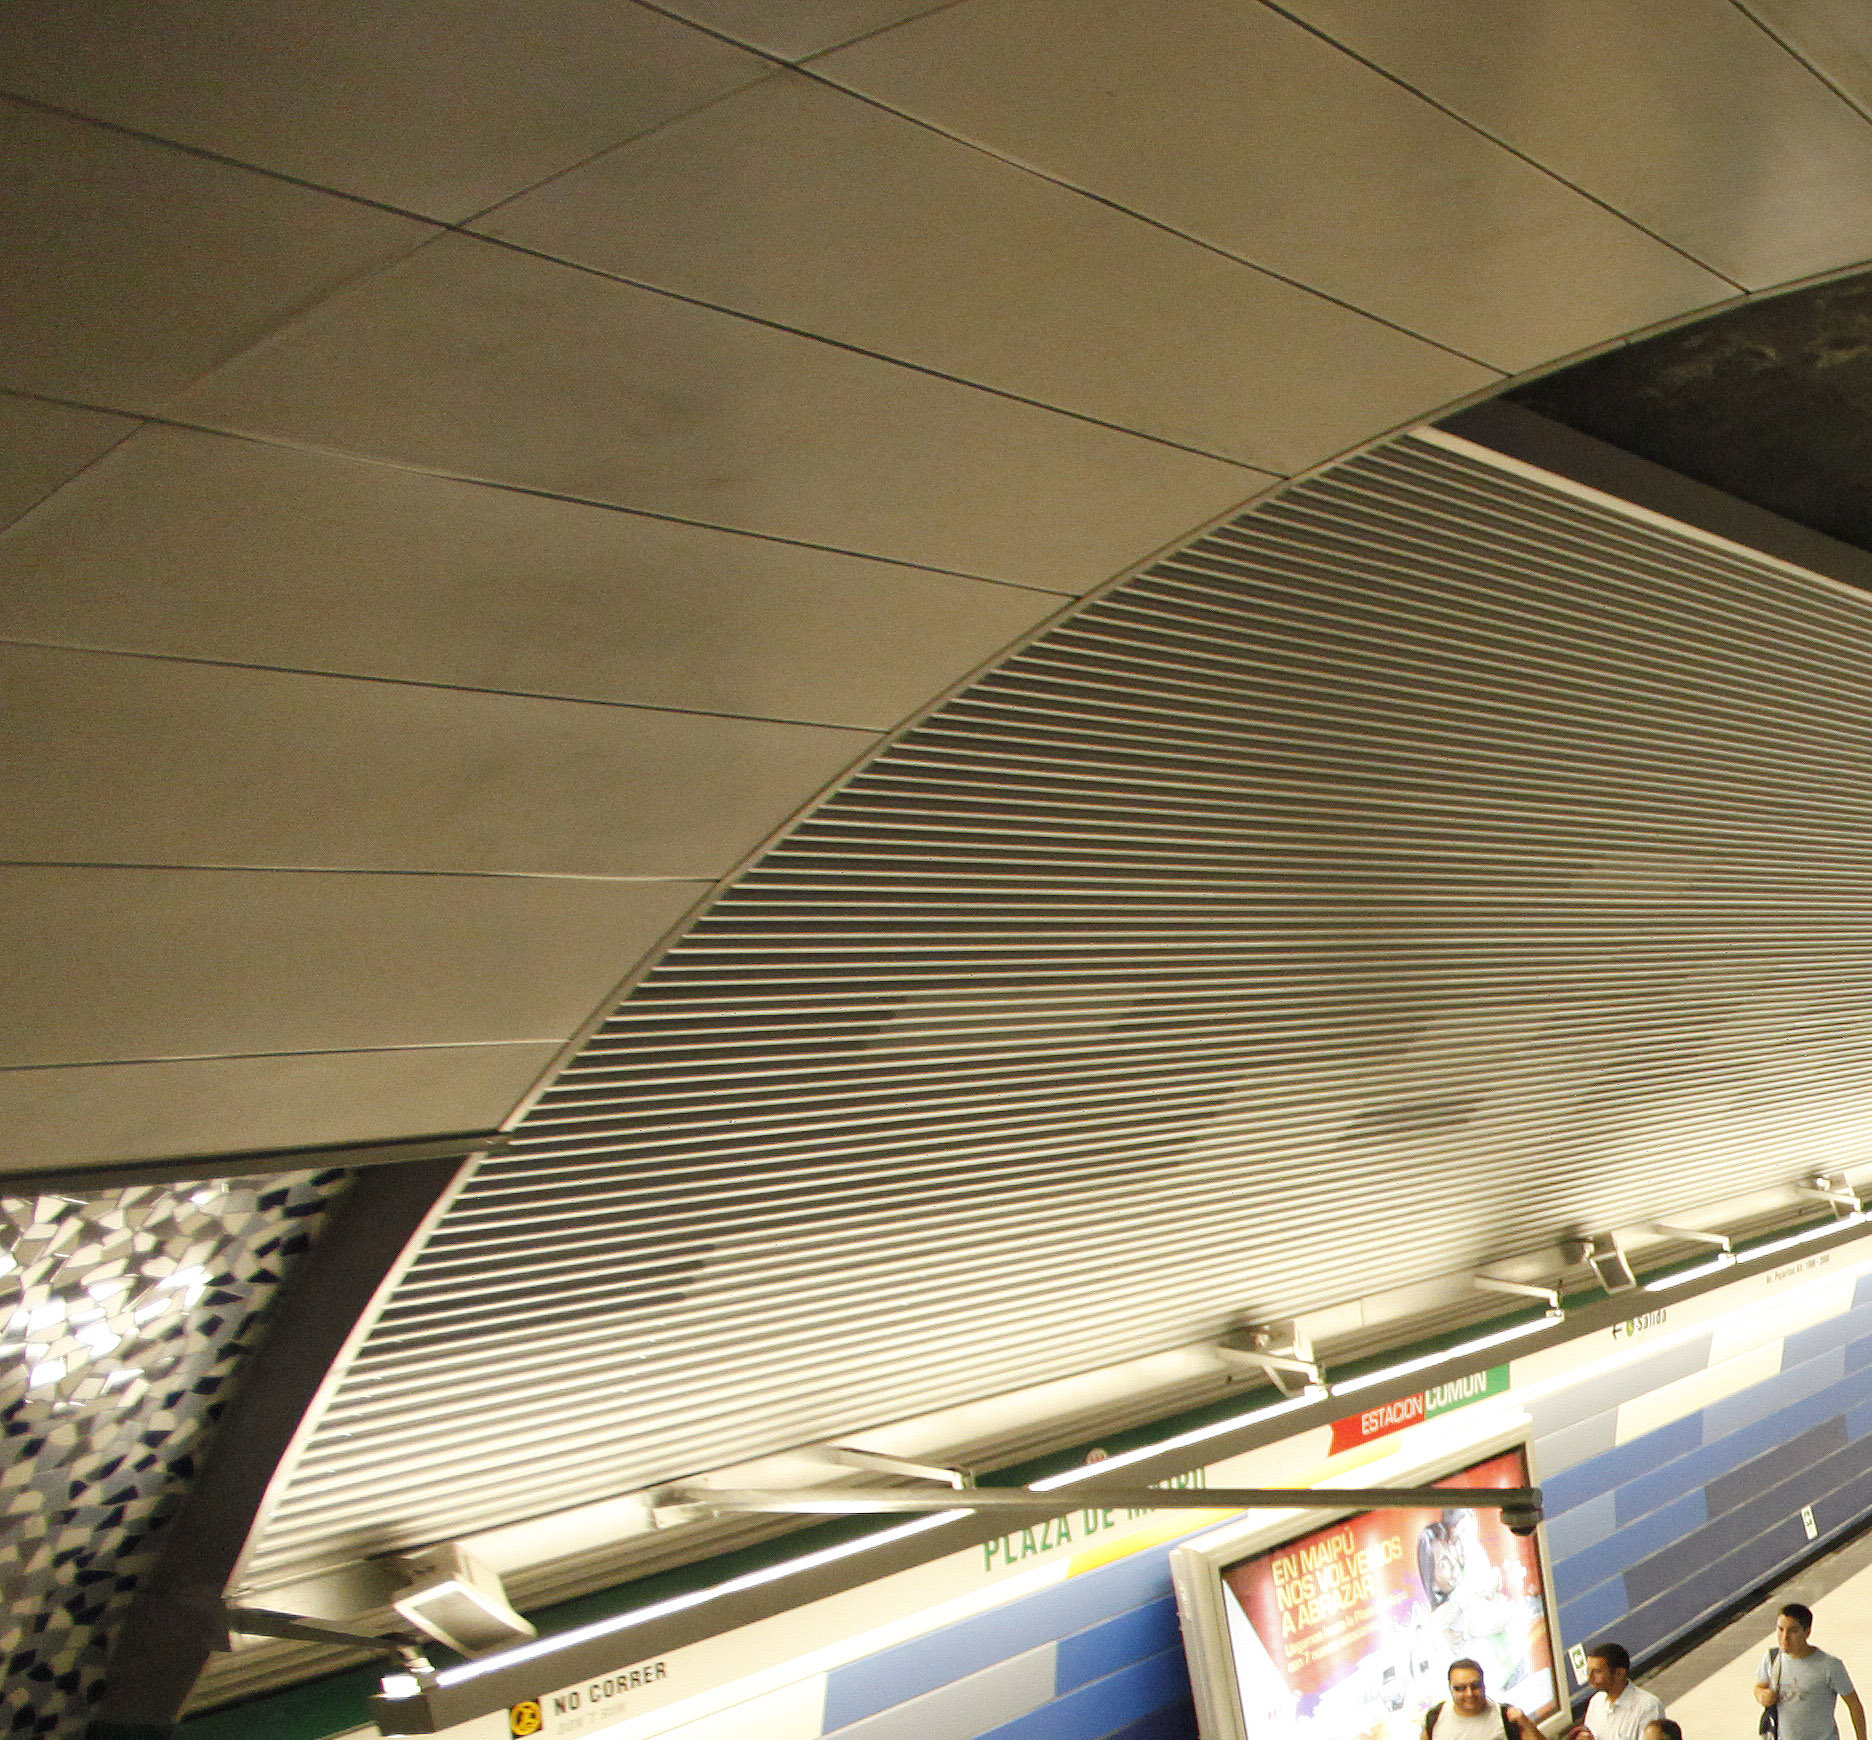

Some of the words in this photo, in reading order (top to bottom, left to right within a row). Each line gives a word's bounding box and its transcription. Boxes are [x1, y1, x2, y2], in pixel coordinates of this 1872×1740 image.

[982, 1514, 1073, 1572] PLAZA
[1271, 1553, 1300, 1587] EN
[1299, 1526, 1356, 1575] MAIPÚ
[1275, 1575, 1316, 1612] NOS
[1281, 1610, 1297, 1639] A
[554, 1690, 580, 1716] NO
[588, 1661, 668, 1703] CORRER
